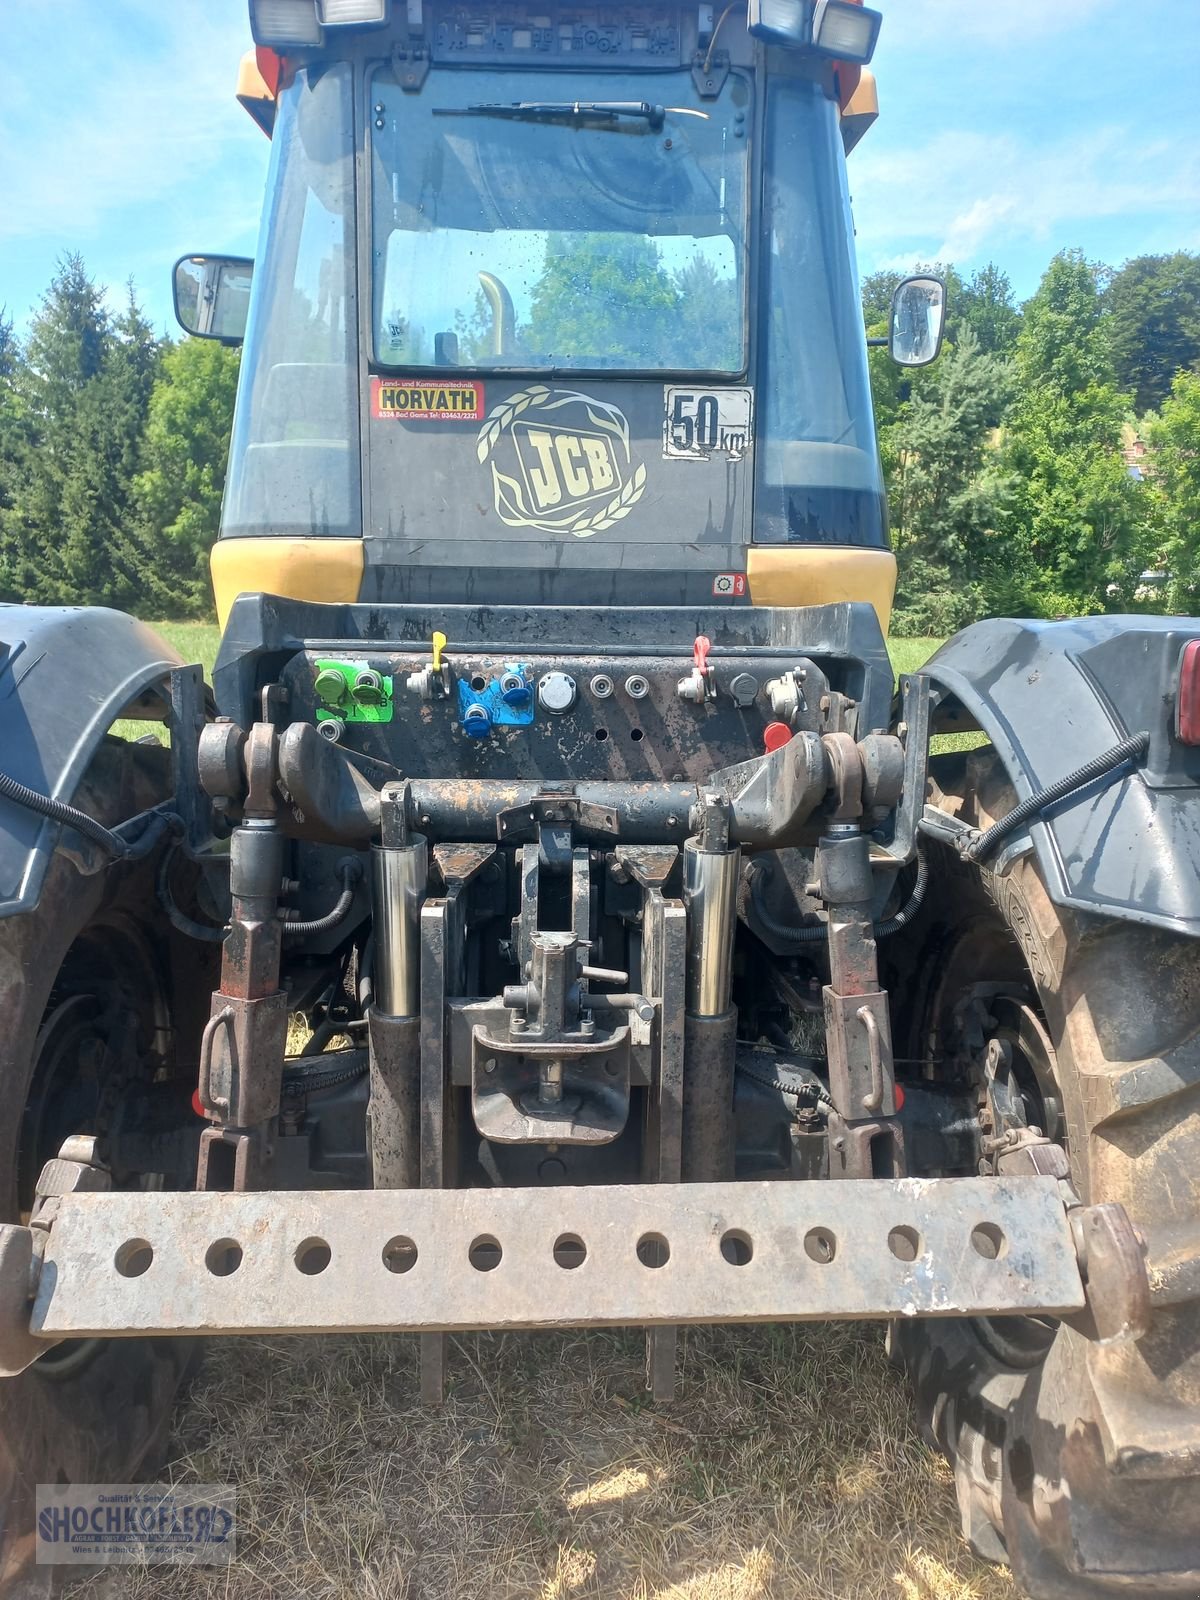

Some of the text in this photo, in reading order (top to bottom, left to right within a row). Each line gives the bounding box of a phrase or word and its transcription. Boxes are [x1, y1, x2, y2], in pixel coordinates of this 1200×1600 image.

[382, 389, 475, 410] HORVATH
[416, 381, 474, 389] Kommunaltechnik
[673, 395, 746, 451] 50 km
[527, 429, 614, 508] JCB
